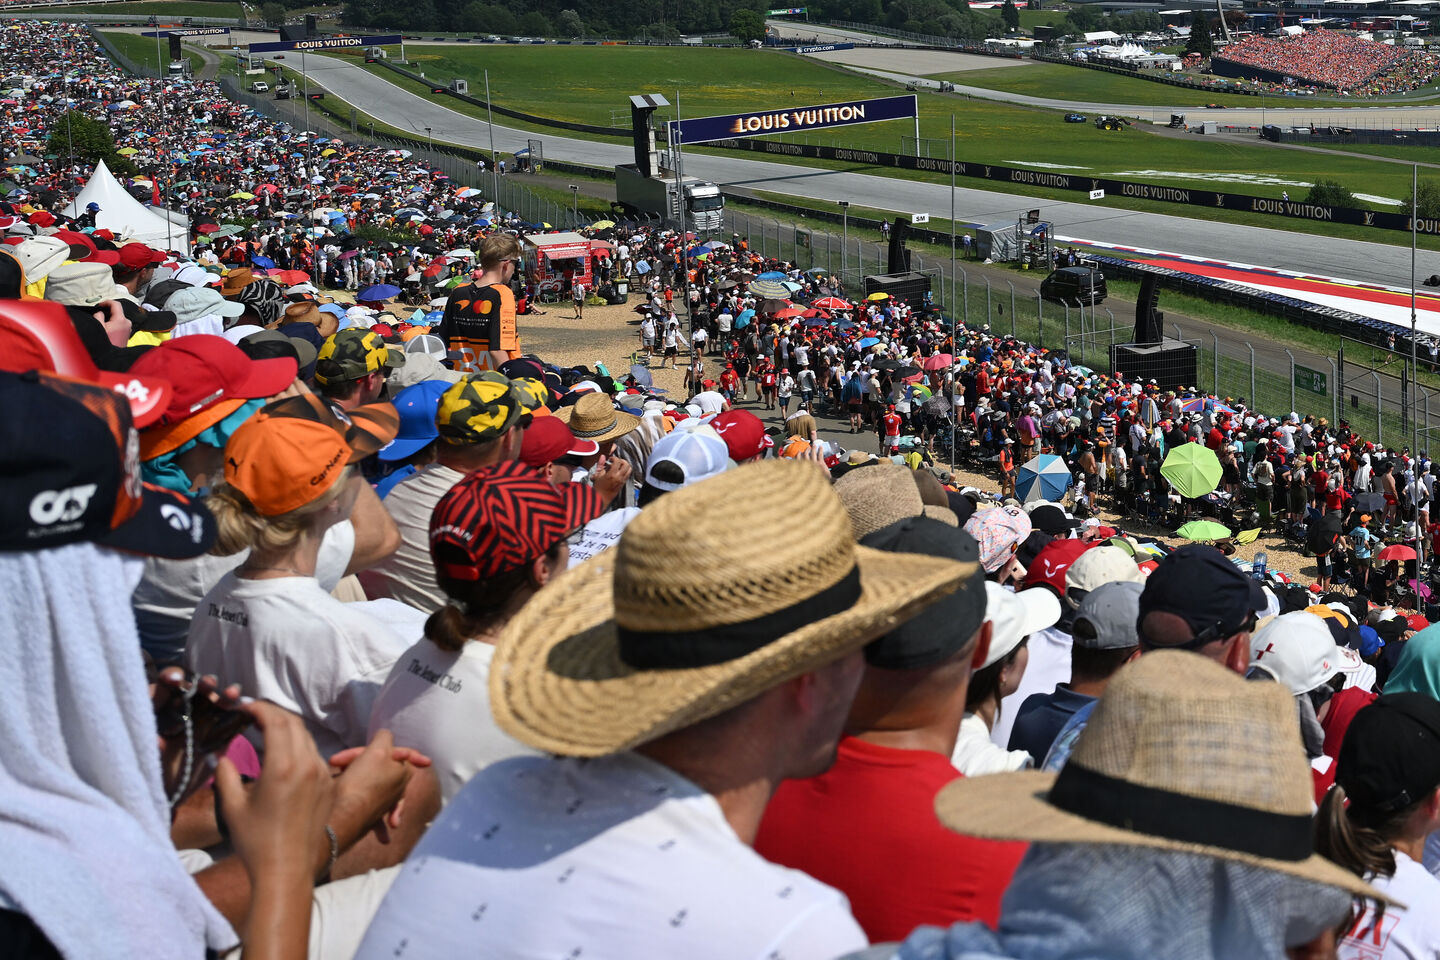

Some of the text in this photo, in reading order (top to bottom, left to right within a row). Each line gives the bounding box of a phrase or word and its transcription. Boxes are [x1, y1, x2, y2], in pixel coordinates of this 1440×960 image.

[296, 38, 362, 49] LOUIS VUITTON
[803, 45, 835, 53] crypto.com
[737, 105, 865, 133] LOUIS VUITTON
[766, 143, 802, 155] LOUIS VUITTON
[835, 150, 878, 163] LOUIS VUITTON
[917, 158, 966, 173] LOUIS VUITON
[1011, 169, 1069, 188] LOUIS VUITTON
[1122, 184, 1190, 203] LOUIS VUITTON
[1253, 198, 1332, 221] LOUIS VUITTON
[208, 603, 220, 619] The
[408, 659, 424, 677] The
[439, 673, 463, 694] Club
